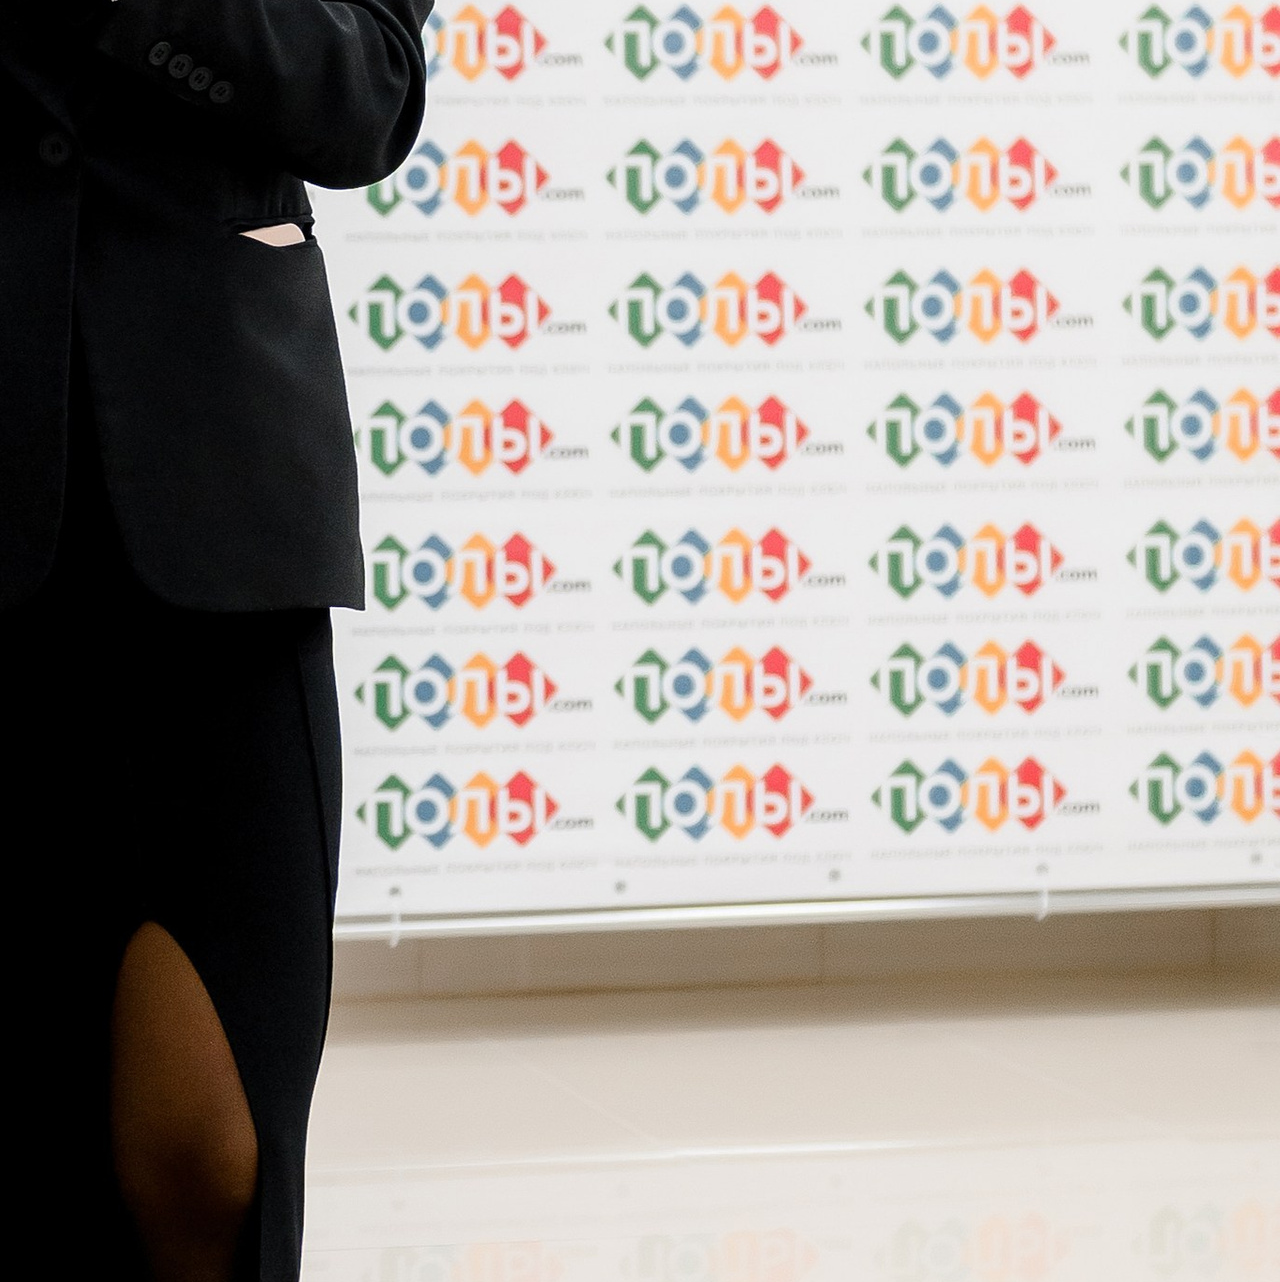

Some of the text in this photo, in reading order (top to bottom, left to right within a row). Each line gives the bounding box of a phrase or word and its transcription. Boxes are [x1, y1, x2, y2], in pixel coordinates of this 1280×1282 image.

[612, 17, 791, 69] ПОЛЫ
[869, 17, 1043, 68] ПОЛЫ
[614, 151, 792, 203] ПОЛЫ
[870, 149, 1045, 200] ПОЛЫ
[358, 286, 539, 339] ПОЛЫ
[616, 284, 794, 336] ПОЛЫ
[872, 281, 1047, 332] ПОЛЫ
[360, 411, 541, 465] ПОЛЫ
[618, 408, 797, 460] ПОЛЫ
[874, 404, 1049, 455] ПОЛЫ
[362, 545, 543, 598] ПОЛЫ
[620, 540, 799, 592] ПОЛЫ
[876, 535, 1052, 586] ПОЛЫ
[364, 664, 545, 717] ПОЛЫ
[622, 658, 801, 710] ПОЛЫ
[878, 652, 1053, 704] ПОЛЫ
[366, 783, 546, 837] ПОЛЫ
[622, 776, 802, 828] ПОЛЫ
[879, 769, 1054, 820] ПОЛЫ
